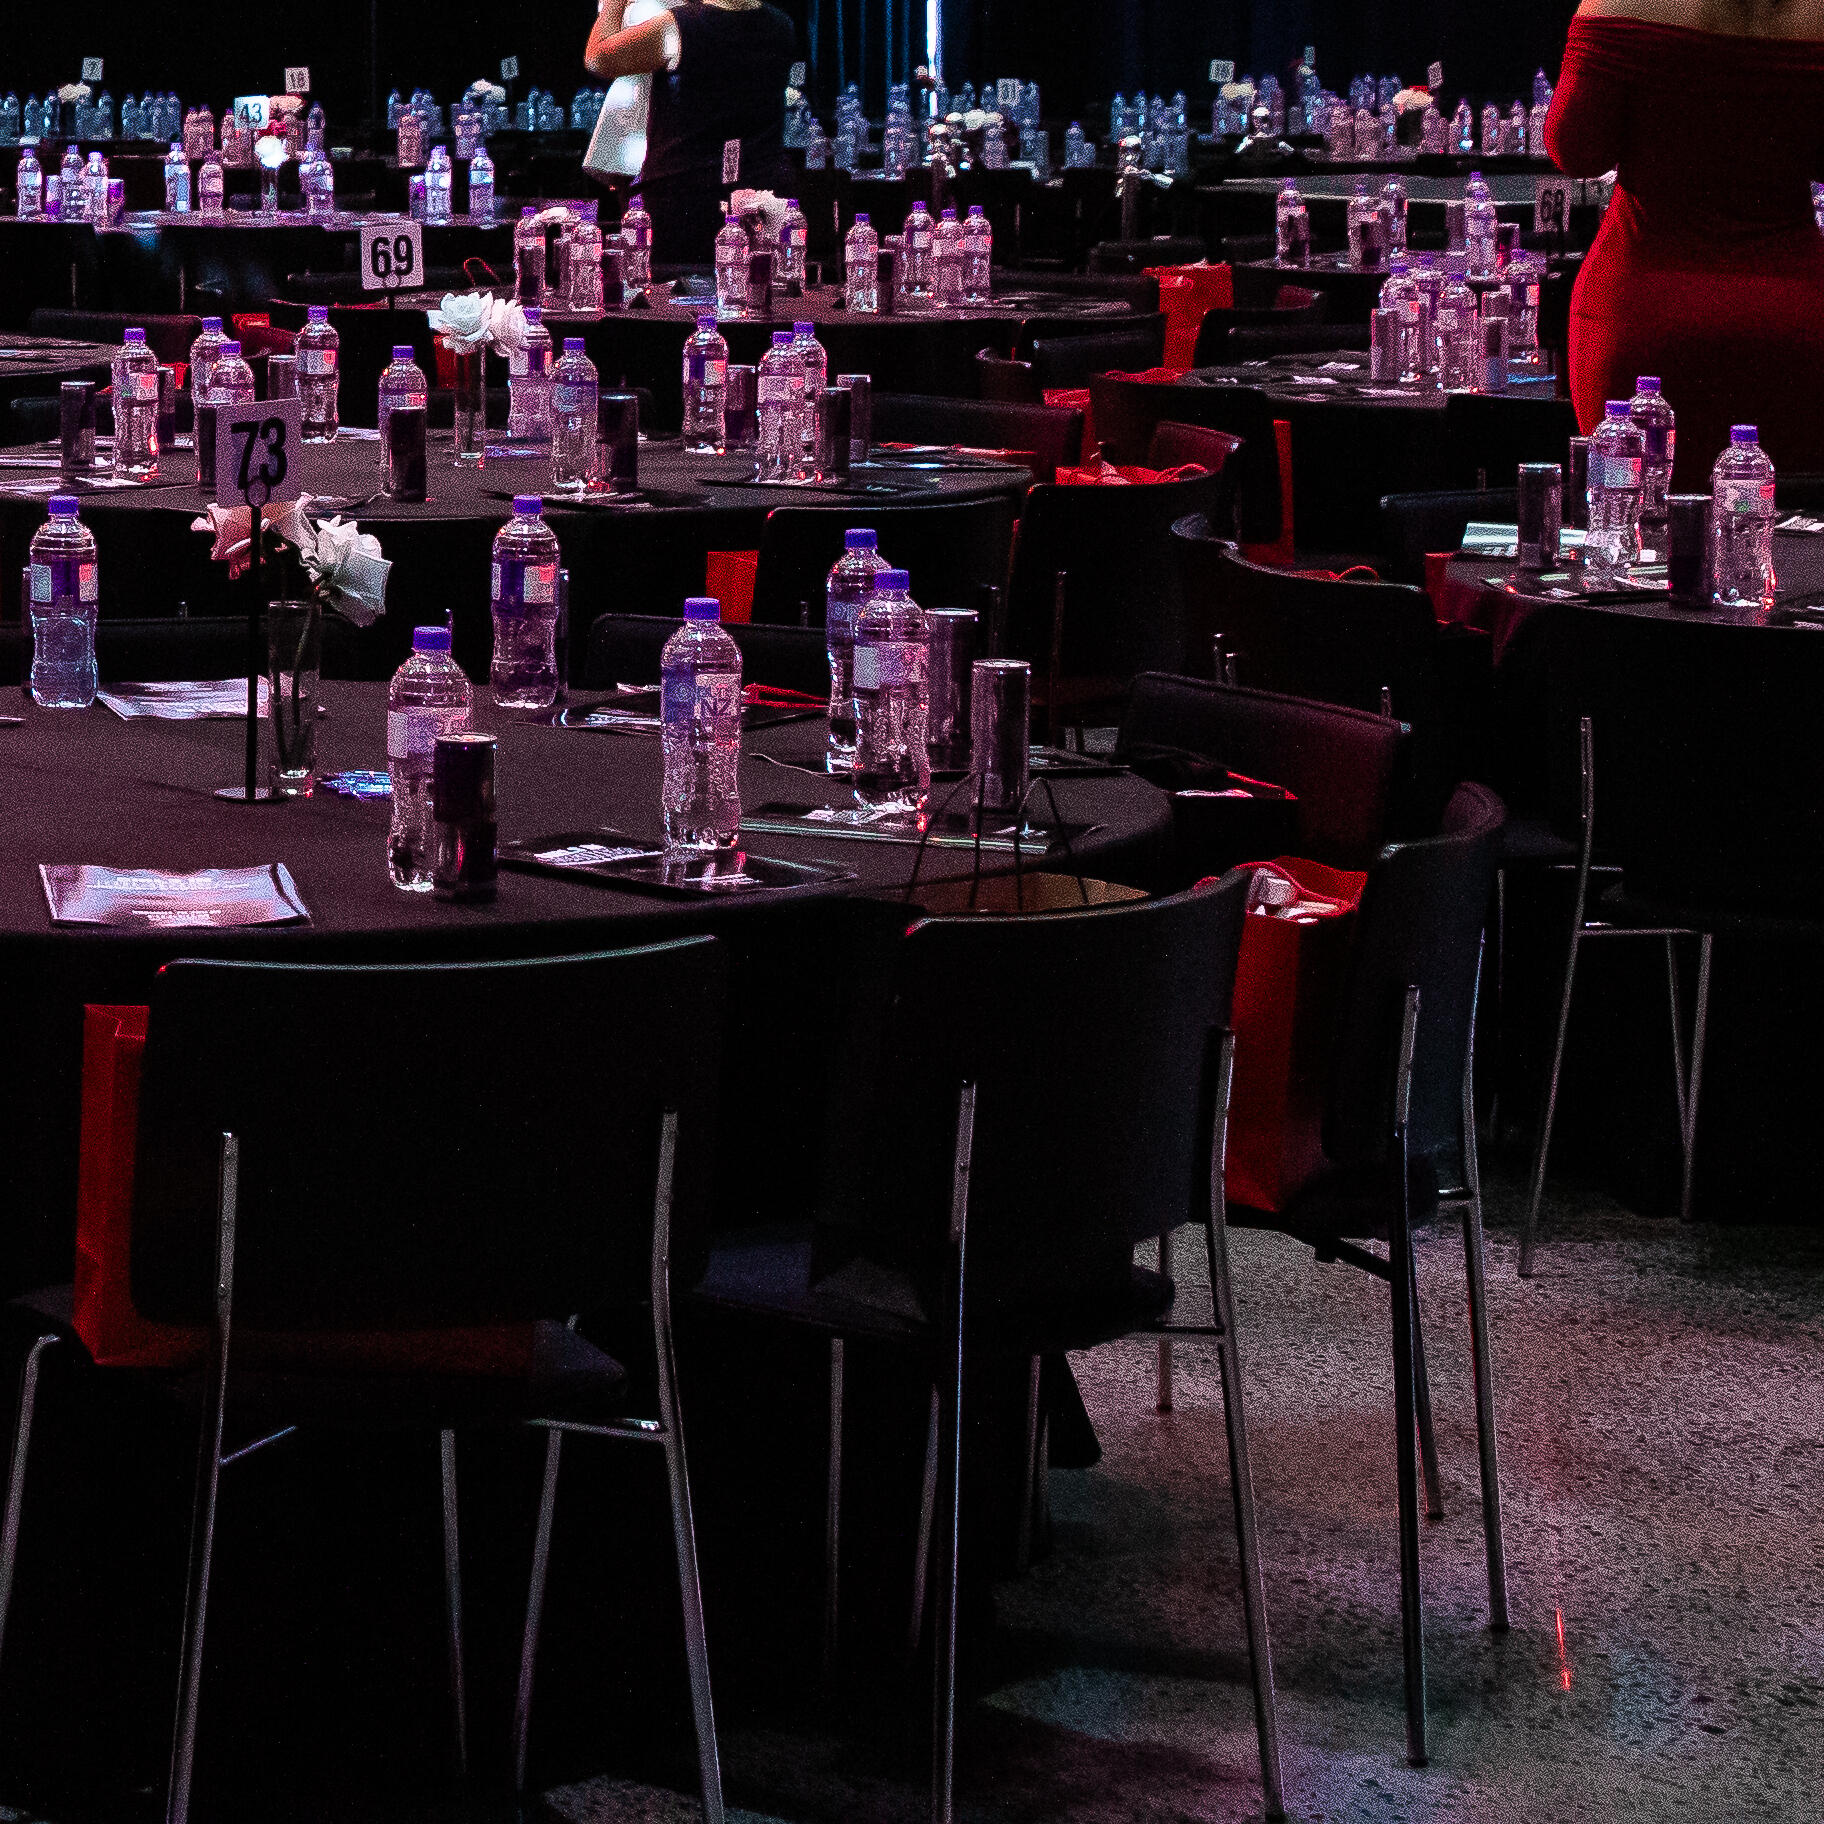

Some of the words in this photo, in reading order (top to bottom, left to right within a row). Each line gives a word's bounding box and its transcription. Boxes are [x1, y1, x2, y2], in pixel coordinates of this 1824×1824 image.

[238, 102, 263, 124] 43
[370, 235, 414, 279] 69
[231, 417, 288, 490] 73
